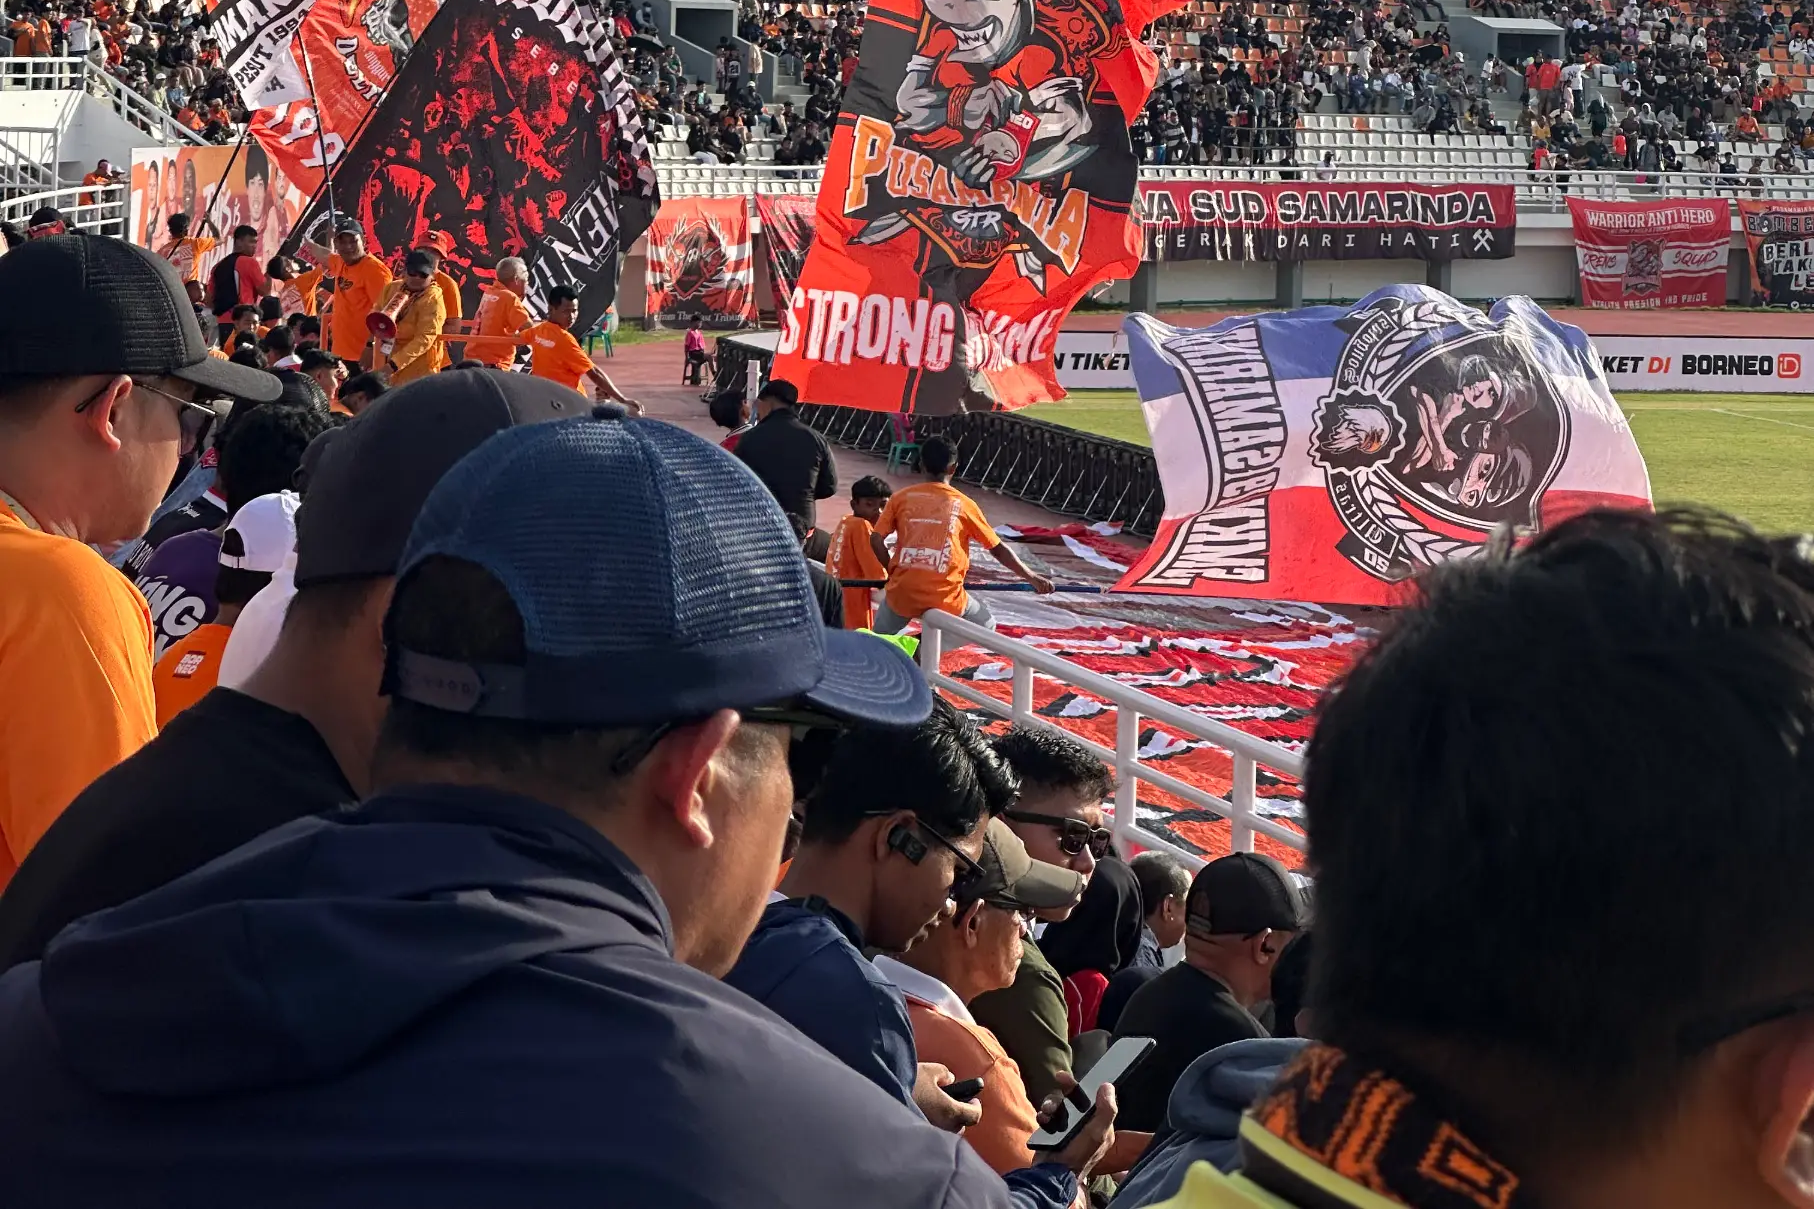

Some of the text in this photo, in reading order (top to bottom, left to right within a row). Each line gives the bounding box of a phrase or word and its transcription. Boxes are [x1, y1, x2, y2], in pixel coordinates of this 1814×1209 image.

[1190, 190, 1266, 223] SUD
[1277, 190, 1495, 224] SAMARINDA
[952, 208, 1002, 233] GTR
[1586, 208, 1715, 228] WARRIOR ANTI HERO
[1278, 233, 1354, 249] DARI
[1380, 233, 1458, 250] HATI
[1672, 250, 1718, 268] SQUAD
[778, 286, 955, 372] STRONG
[1648, 357, 1671, 373] DI
[1682, 355, 1773, 375] BORNEO
